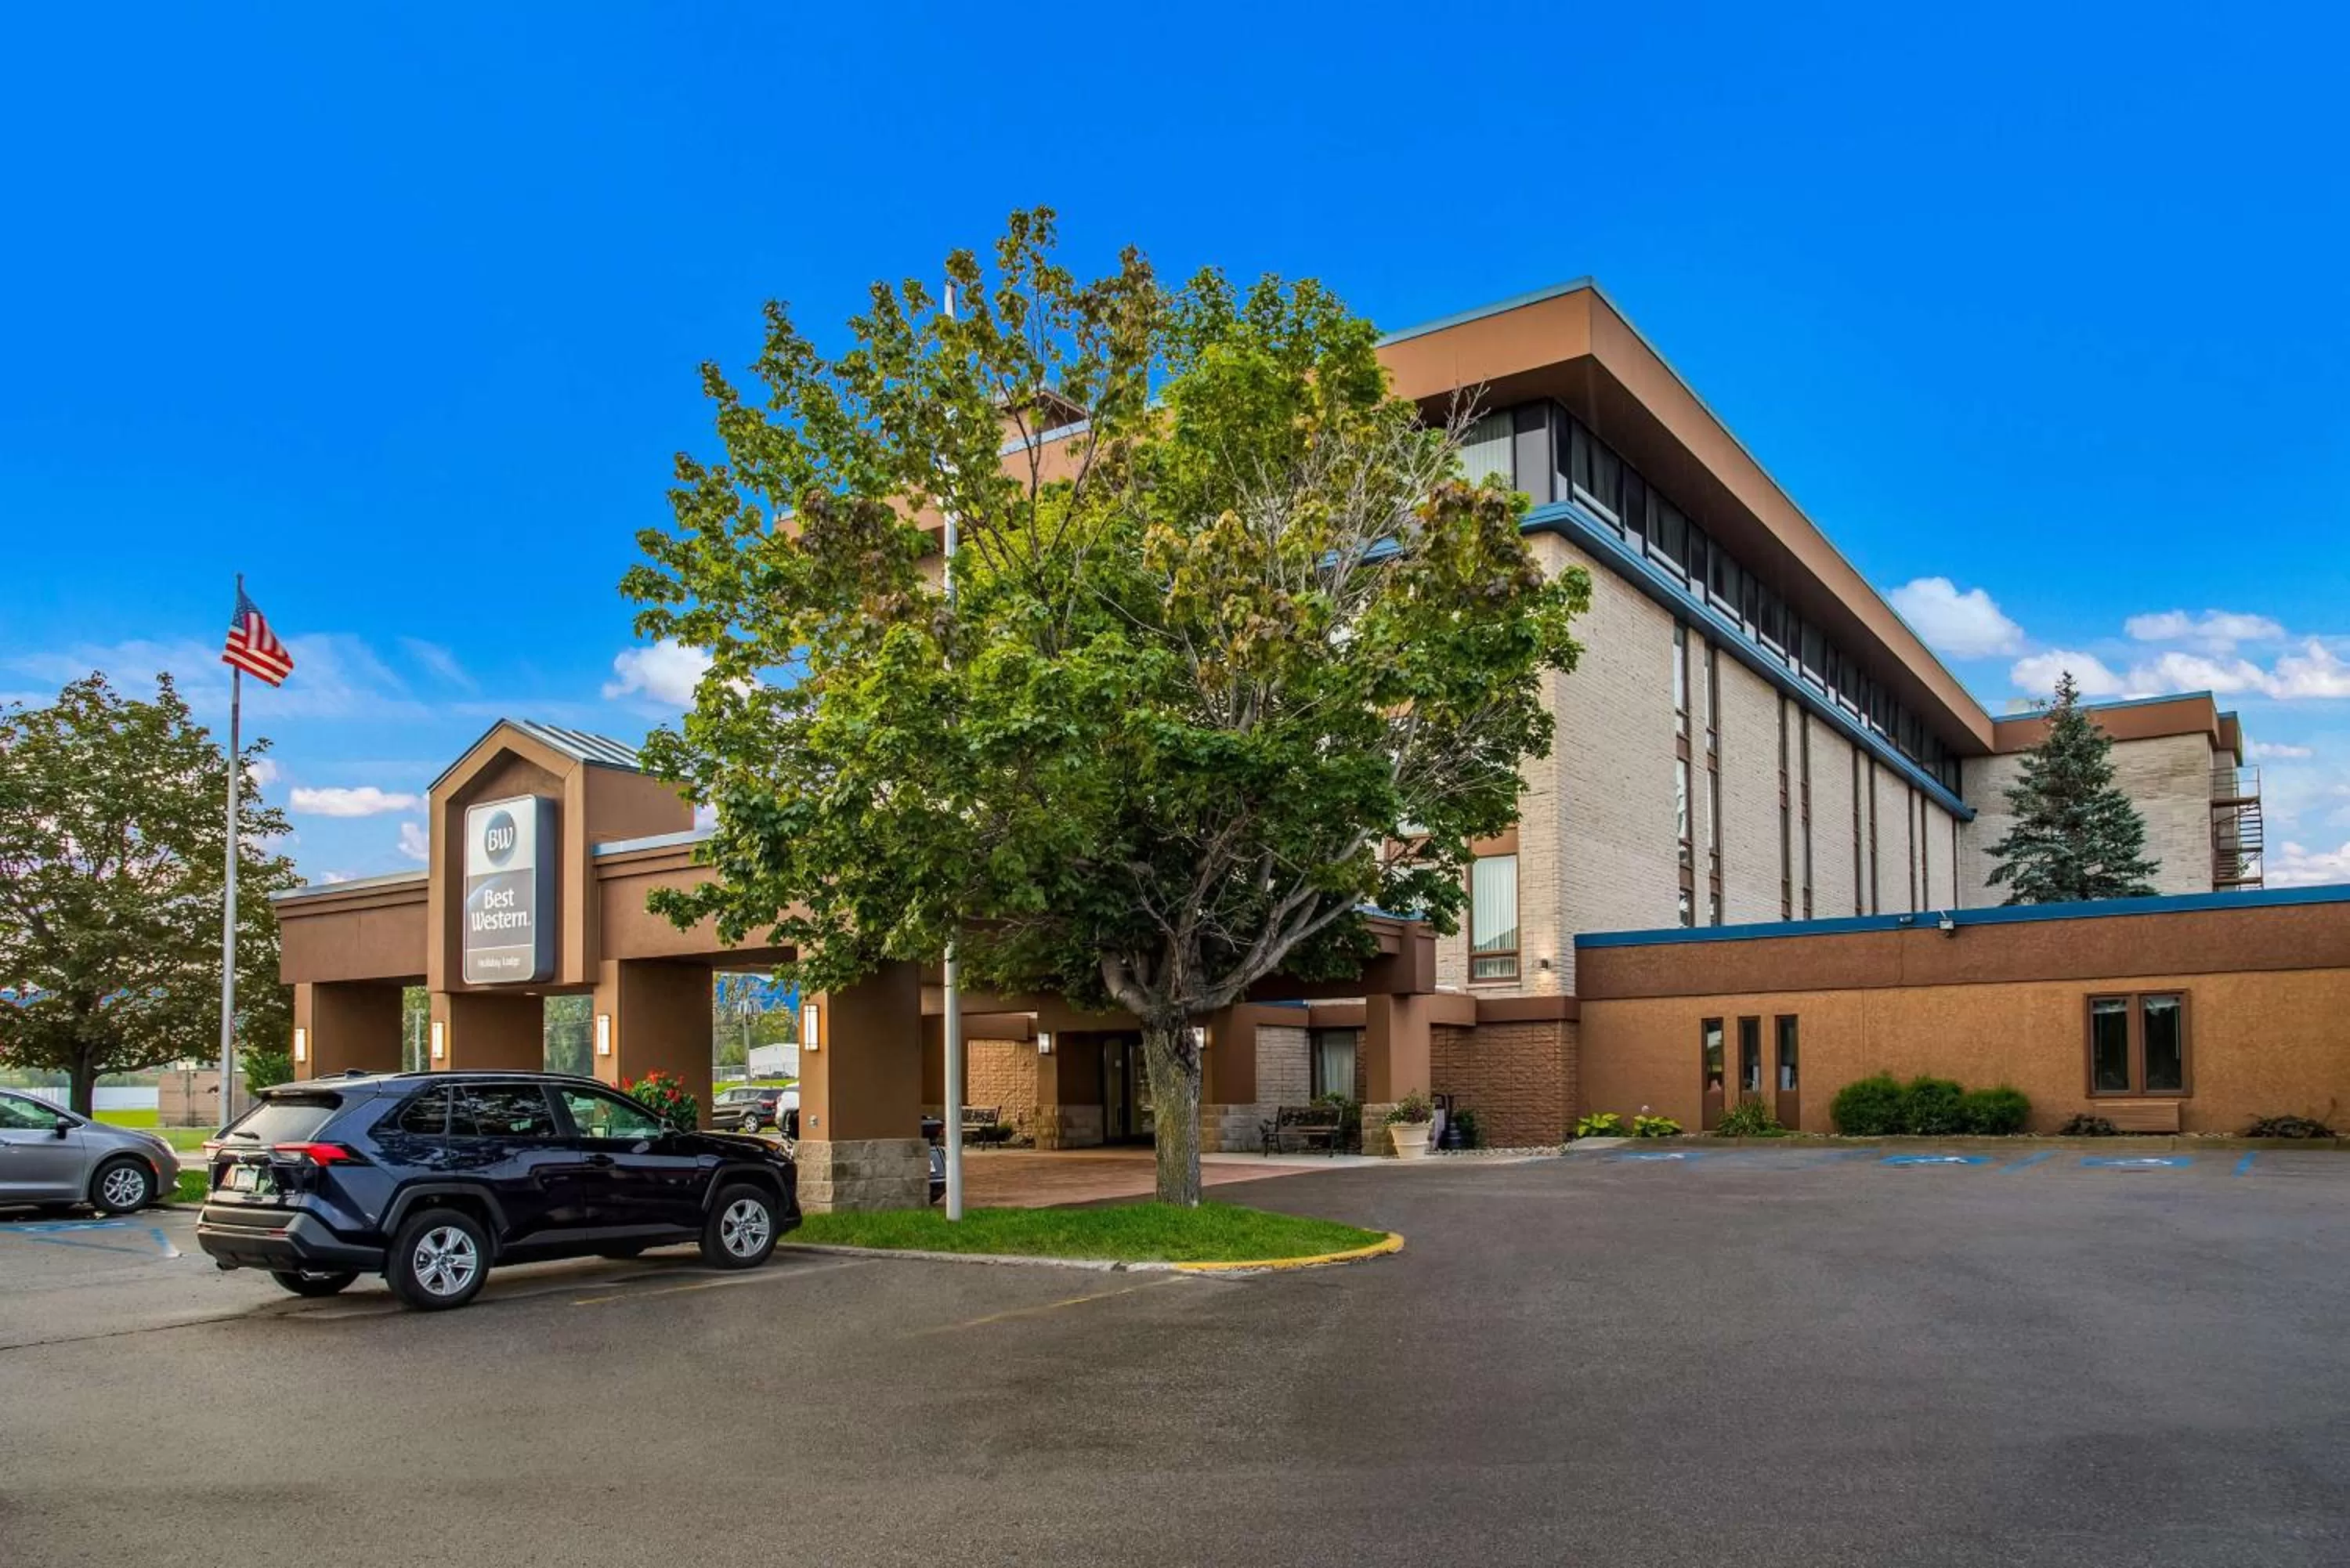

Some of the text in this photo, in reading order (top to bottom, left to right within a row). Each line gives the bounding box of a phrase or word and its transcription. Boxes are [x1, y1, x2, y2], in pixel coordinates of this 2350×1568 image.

[487, 826, 513, 851] BW
[485, 889, 514, 909] Best
[472, 910, 527, 930] Western
